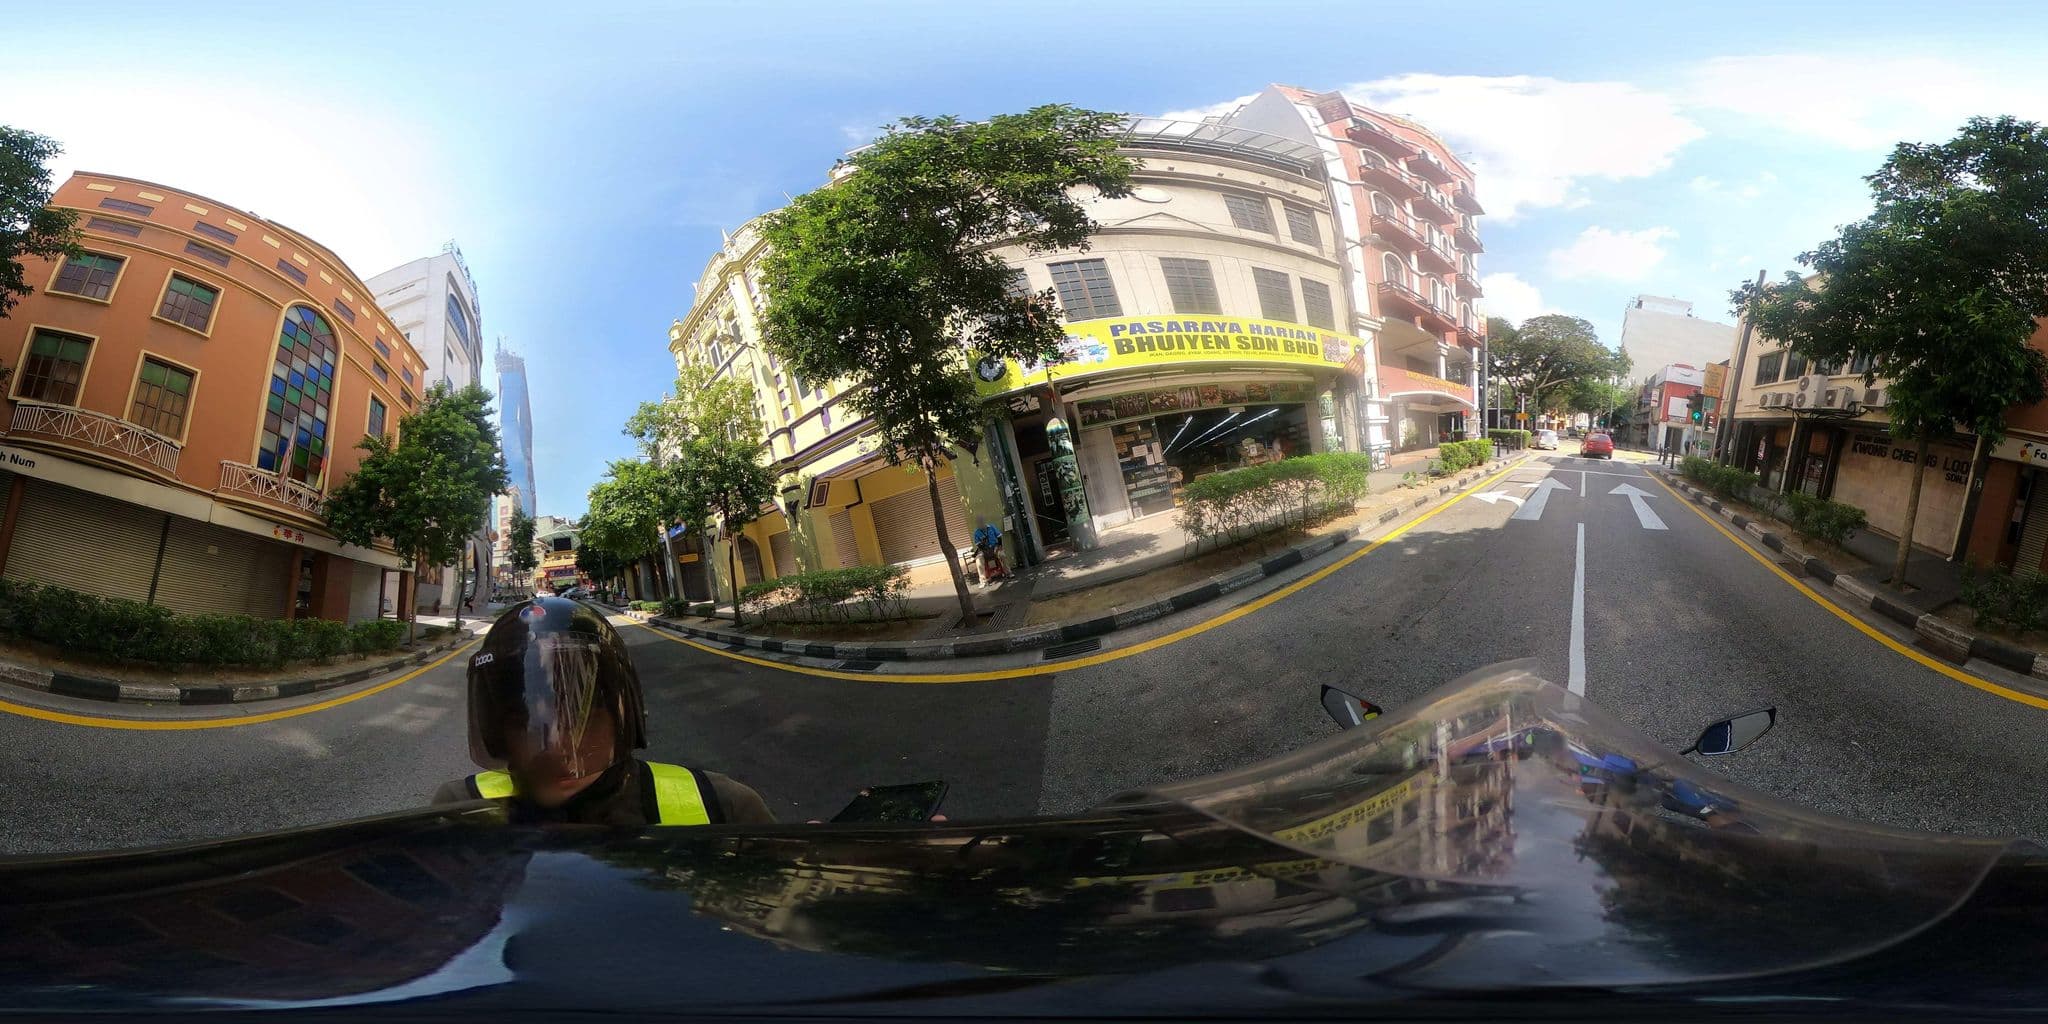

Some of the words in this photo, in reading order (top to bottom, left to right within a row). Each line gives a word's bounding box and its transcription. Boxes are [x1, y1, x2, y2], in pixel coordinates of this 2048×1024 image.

[1110, 321, 1243, 337] PASARAYA
[1249, 323, 1317, 341] HARIAN
[1114, 334, 1230, 355] BHUIYEN
[1236, 335, 1279, 352] SDN
[1283, 339, 1319, 356] BHD
[10, 453, 36, 469] Num
[1852, 441, 1888, 458] KWONG
[1943, 456, 1971, 475] LOO
